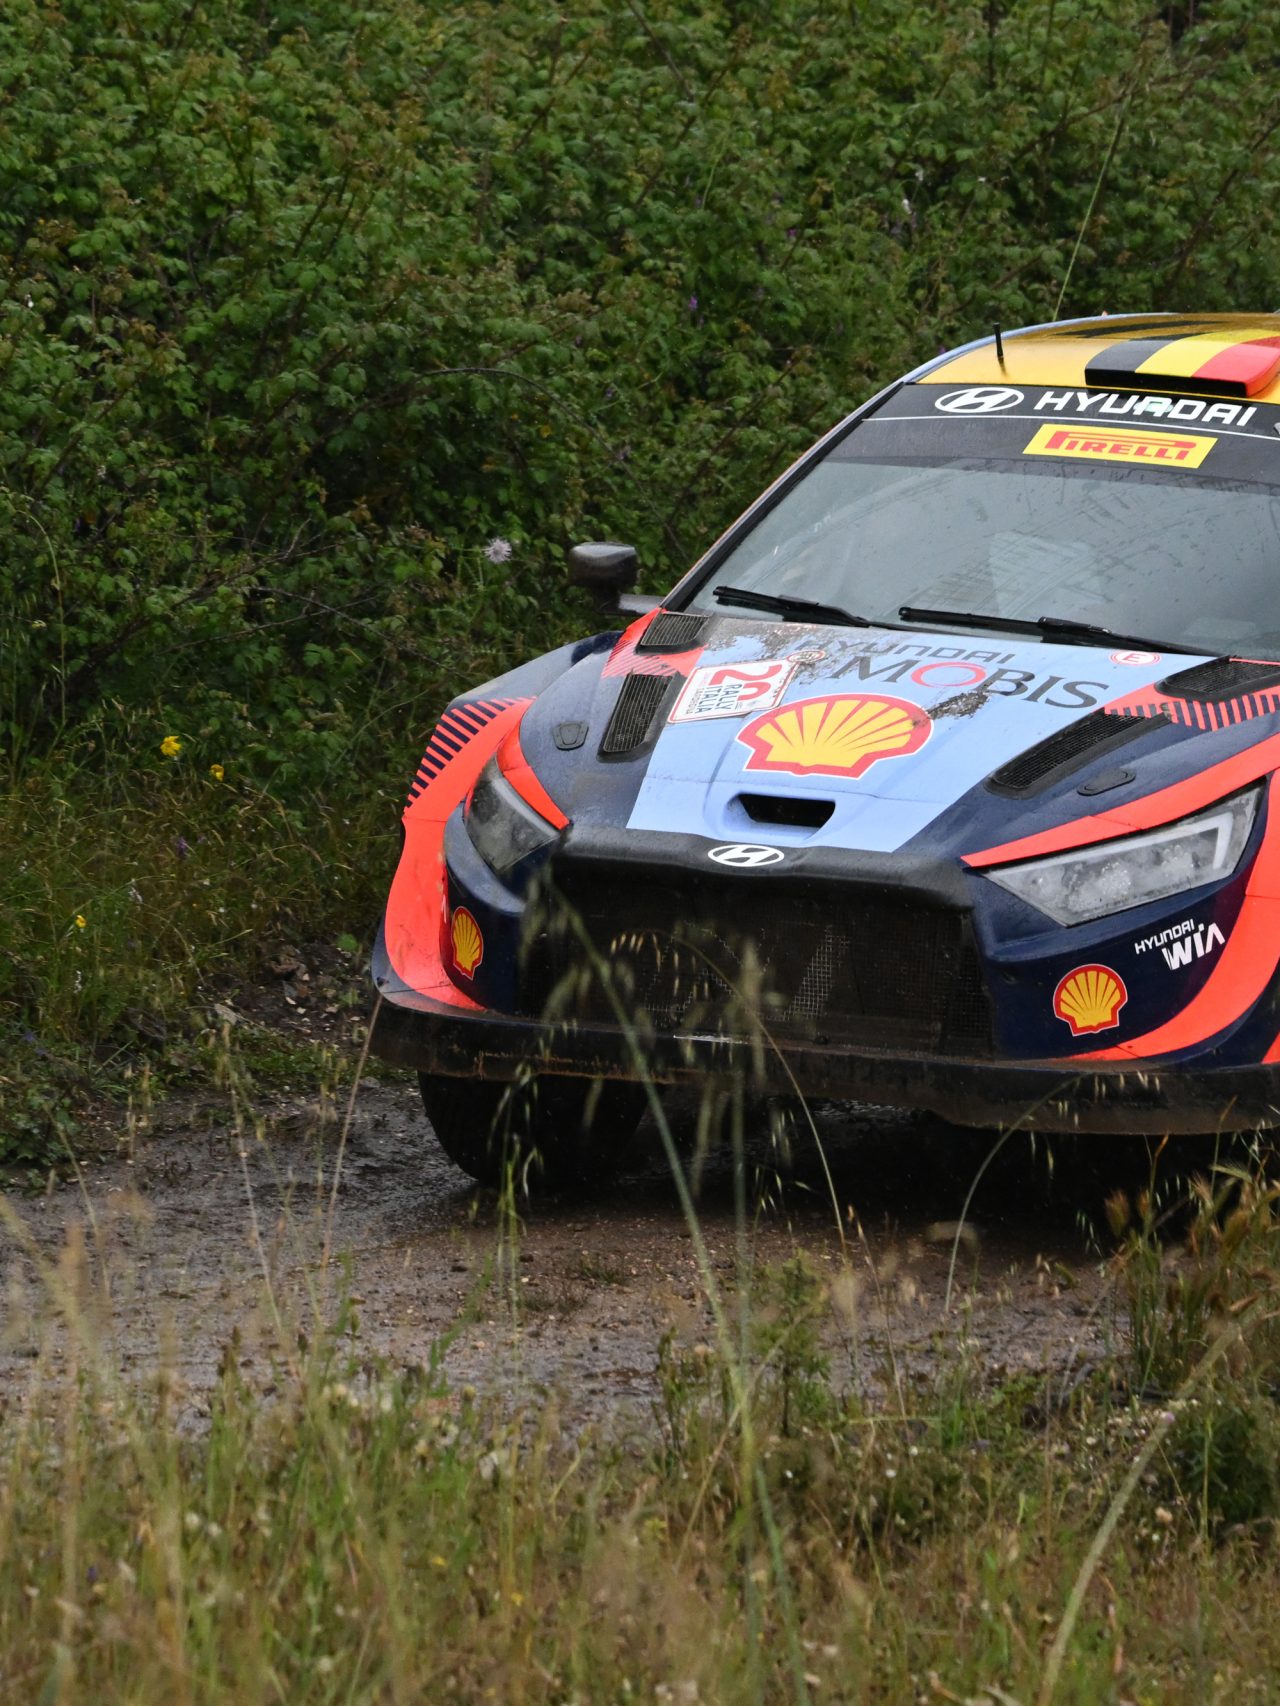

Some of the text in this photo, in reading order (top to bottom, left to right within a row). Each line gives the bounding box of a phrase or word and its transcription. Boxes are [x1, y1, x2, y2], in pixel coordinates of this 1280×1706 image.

[1034, 391, 1257, 428] HYUNDAI
[1045, 429, 1197, 462] PIRELLI
[1123, 651, 1143, 664] E
[714, 683, 743, 710] RALLY
[827, 655, 1109, 709] MOBIS
[695, 685, 724, 714] ITALIA
[1134, 918, 1195, 954] HYUNDAI
[1161, 922, 1226, 970] WIA
